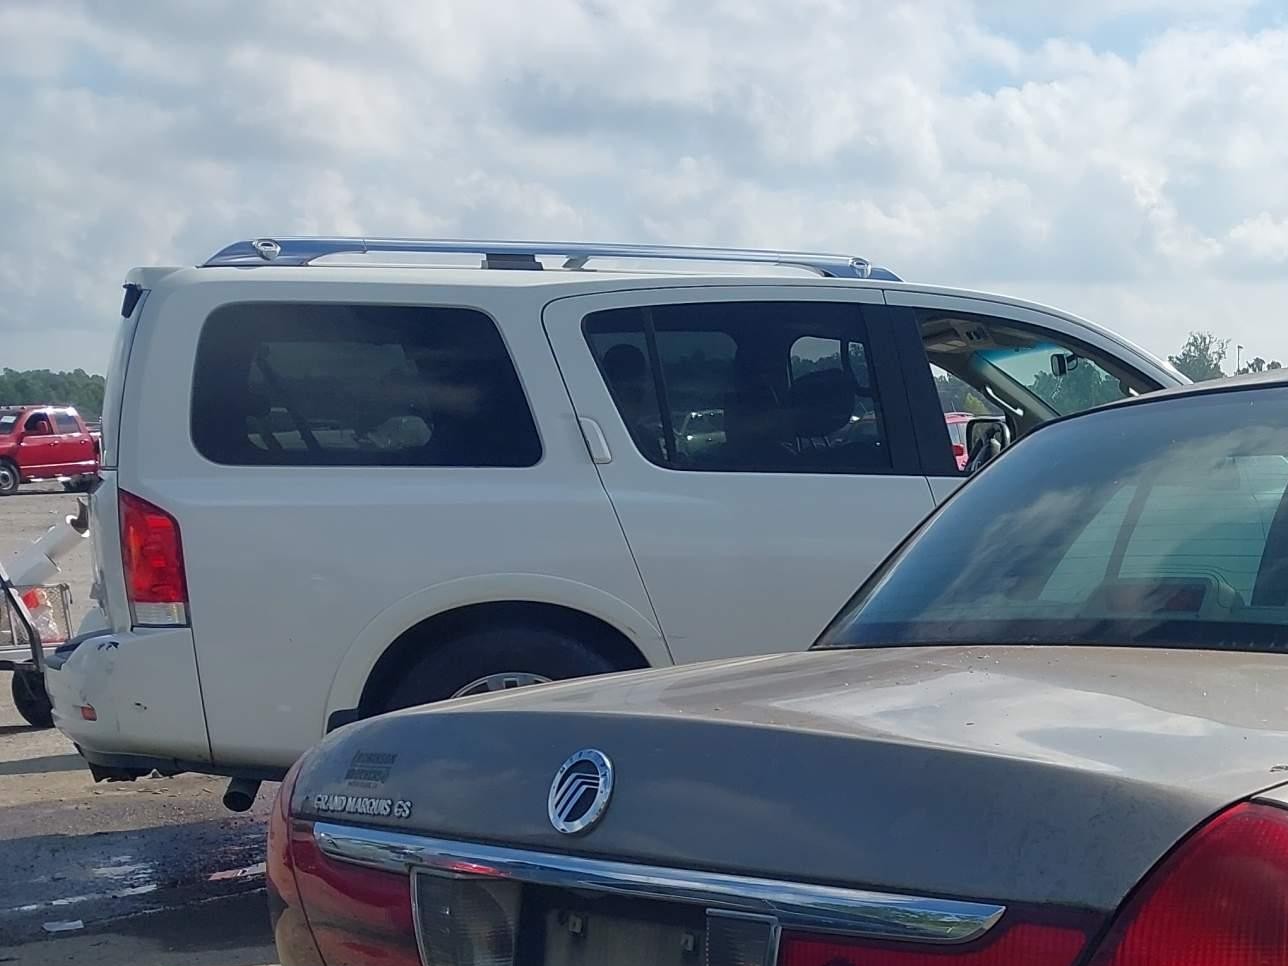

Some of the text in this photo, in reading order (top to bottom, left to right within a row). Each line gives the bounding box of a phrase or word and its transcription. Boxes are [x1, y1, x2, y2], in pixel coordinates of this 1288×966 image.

[313, 794, 412, 817] GRAND MARQUIS GS
